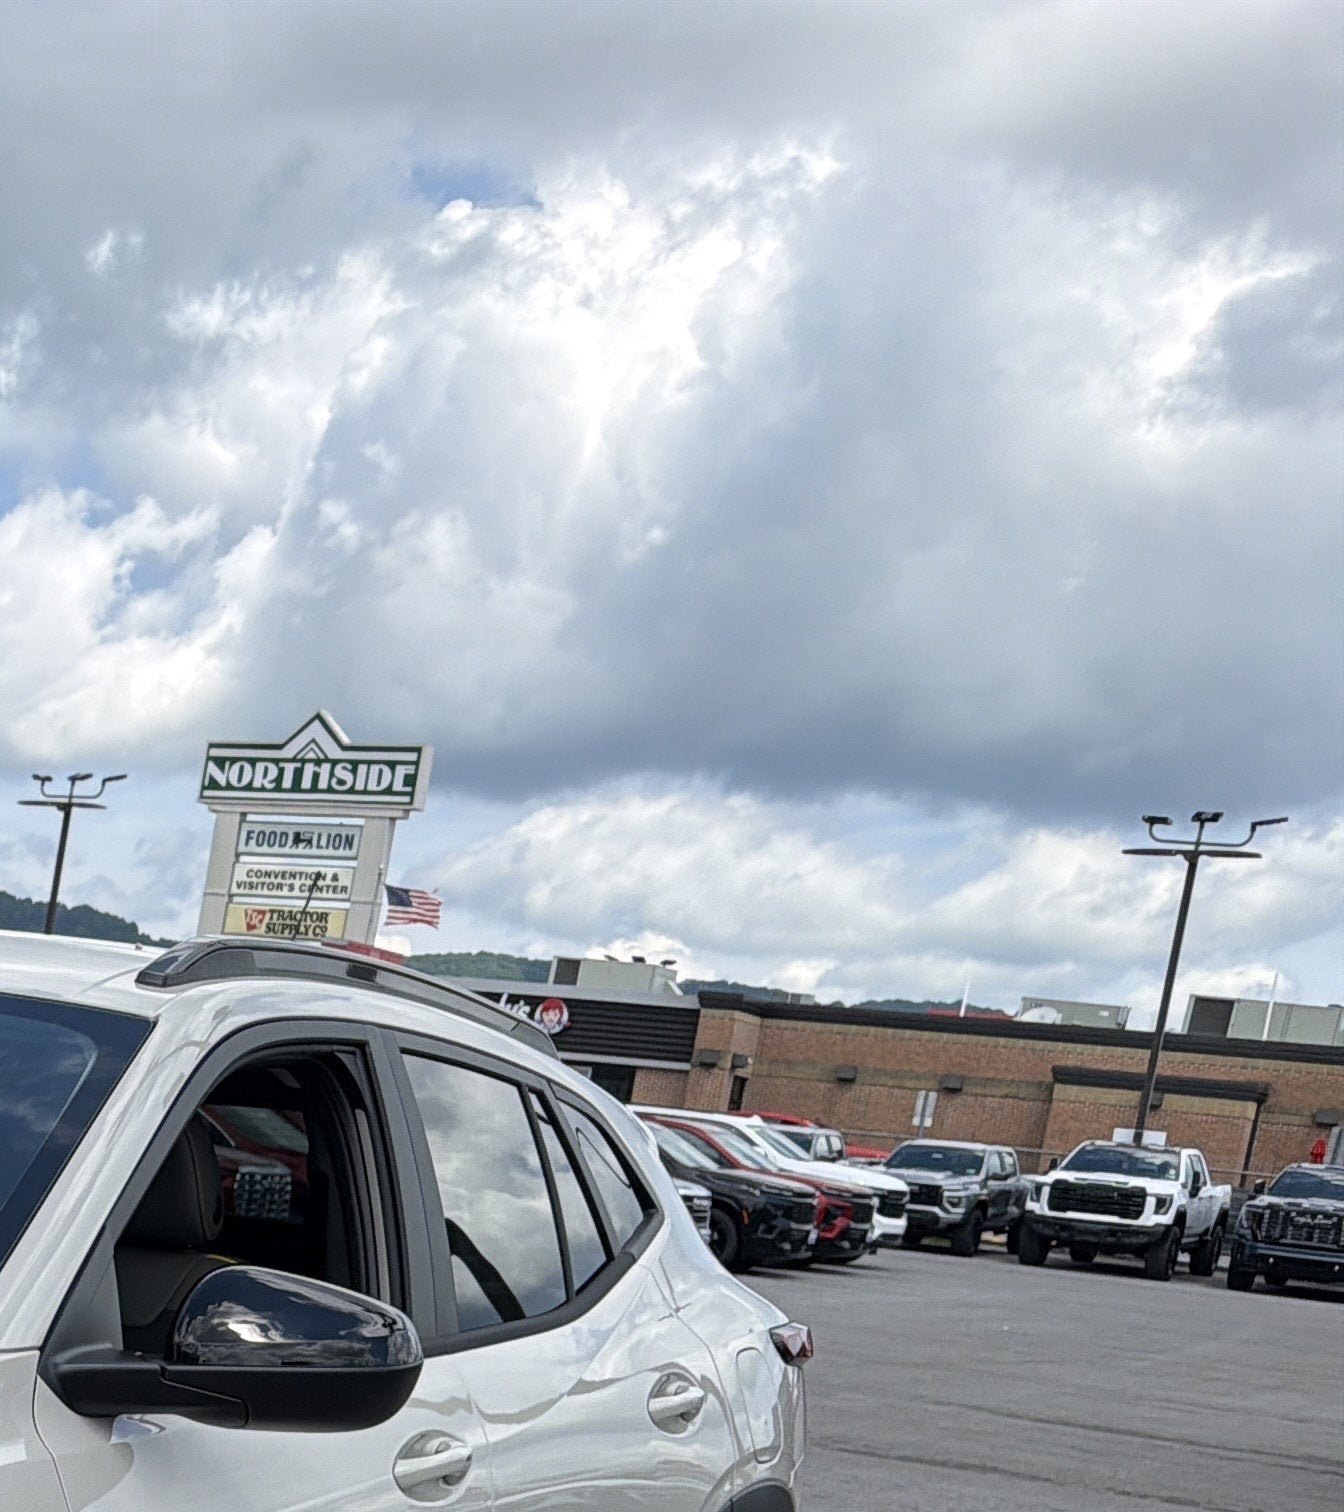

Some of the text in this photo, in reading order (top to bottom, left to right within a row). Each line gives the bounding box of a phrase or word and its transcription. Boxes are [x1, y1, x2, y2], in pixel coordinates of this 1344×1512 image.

[205, 760, 416, 792] NORTHSIDE
[244, 829, 355, 851] FOOD LION
[246, 869, 340, 883] CONVENTION &
[236, 881, 348, 896] VISITOR'S CENTER
[268, 909, 329, 924] TRACTOR
[265, 922, 311, 936] SUPPLY
